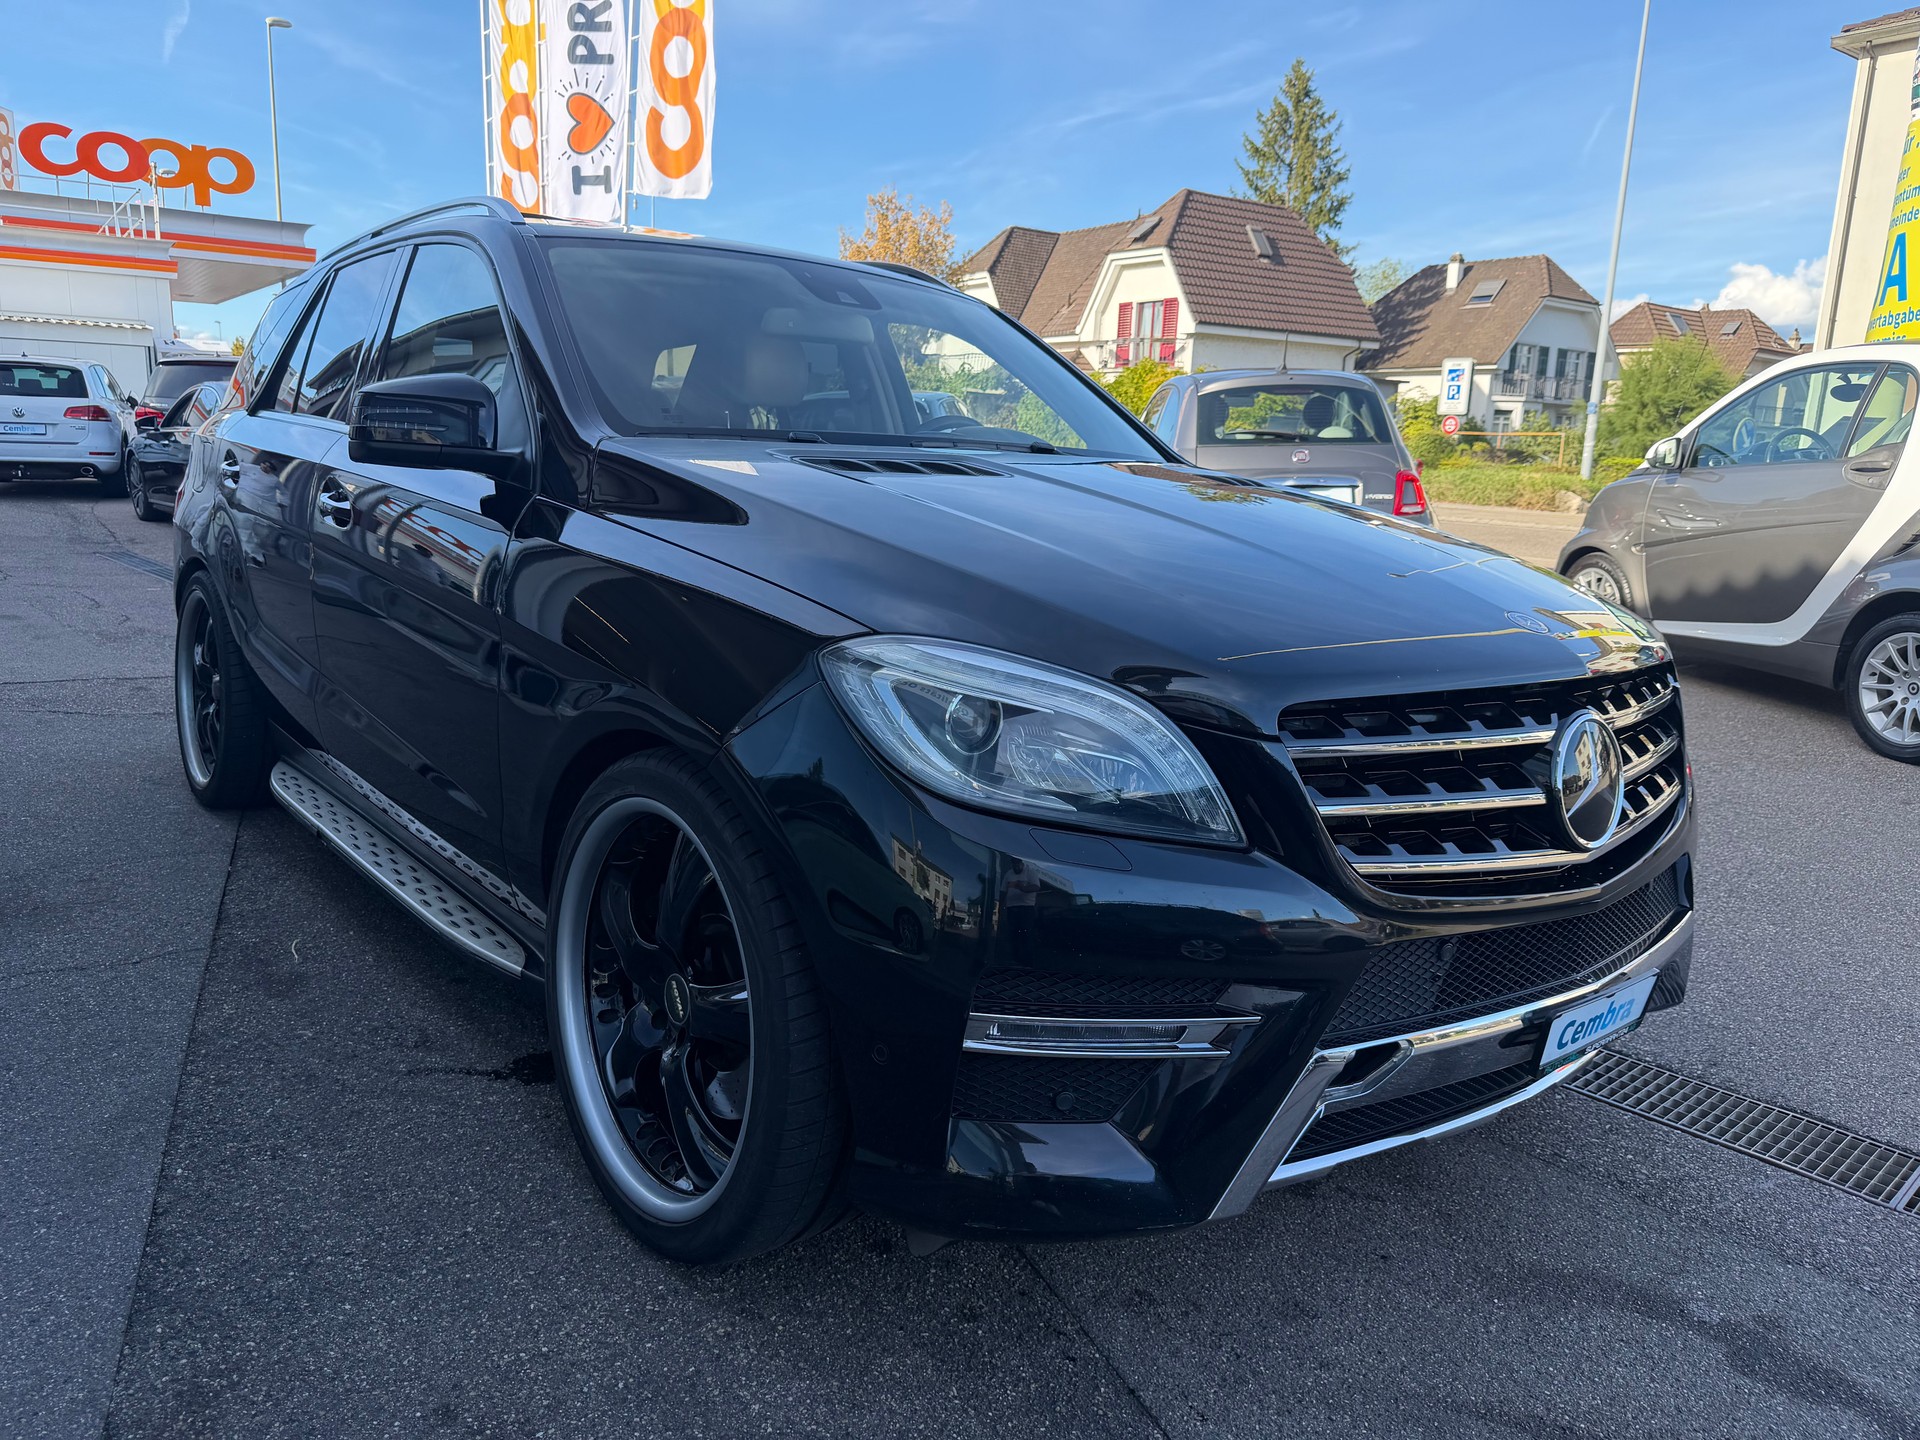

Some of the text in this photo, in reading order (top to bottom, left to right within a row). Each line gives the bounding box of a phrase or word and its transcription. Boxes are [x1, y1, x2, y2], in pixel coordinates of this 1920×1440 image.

[566, 0, 615, 195] I PR
[1557, 998, 1635, 1051] Cembra
